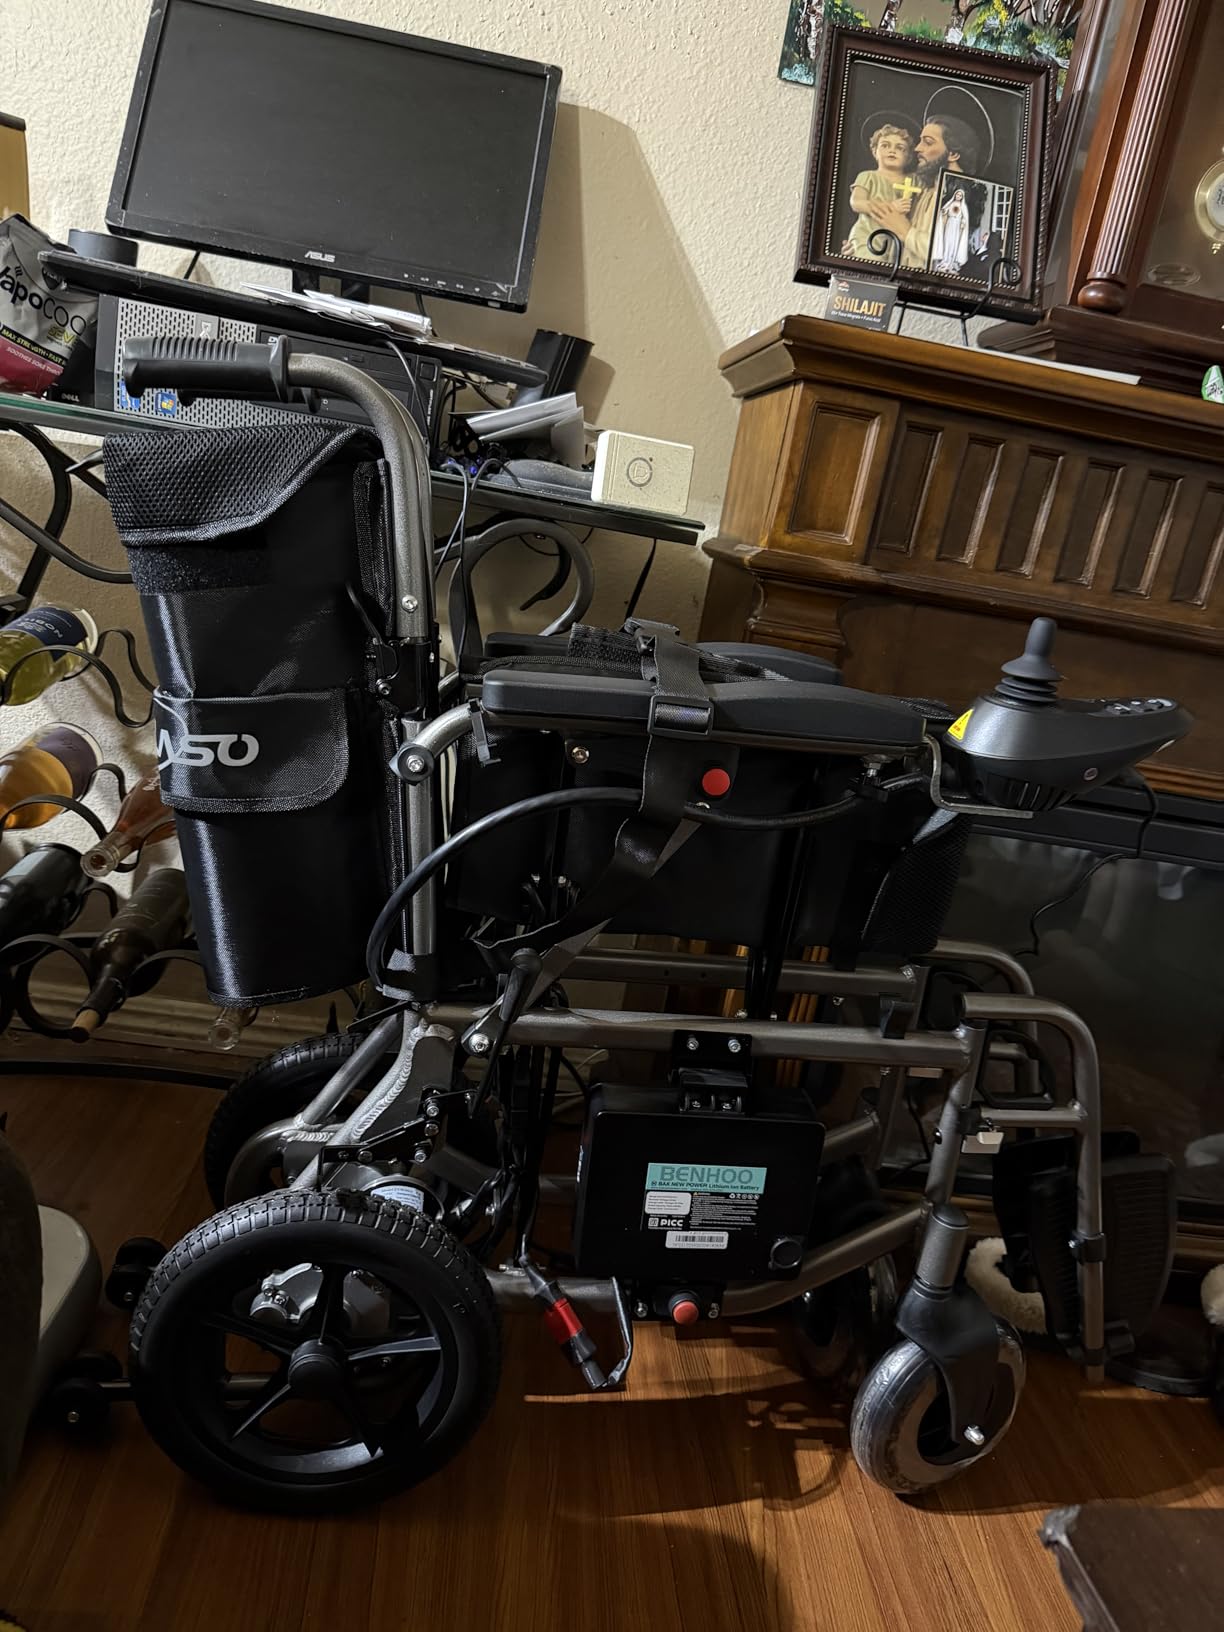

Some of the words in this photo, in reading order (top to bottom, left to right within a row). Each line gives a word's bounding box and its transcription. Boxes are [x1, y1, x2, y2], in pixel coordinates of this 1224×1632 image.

[304, 251, 335, 263] ASUS
[833, 296, 886, 317] SHILAJIT
[1, 328, 16, 341] MAX
[48, 352, 63, 364] FAST
[61, 393, 80, 402] DELL
[660, 1166, 753, 1184] BENHOO
[660, 1219, 684, 1227] PICC
